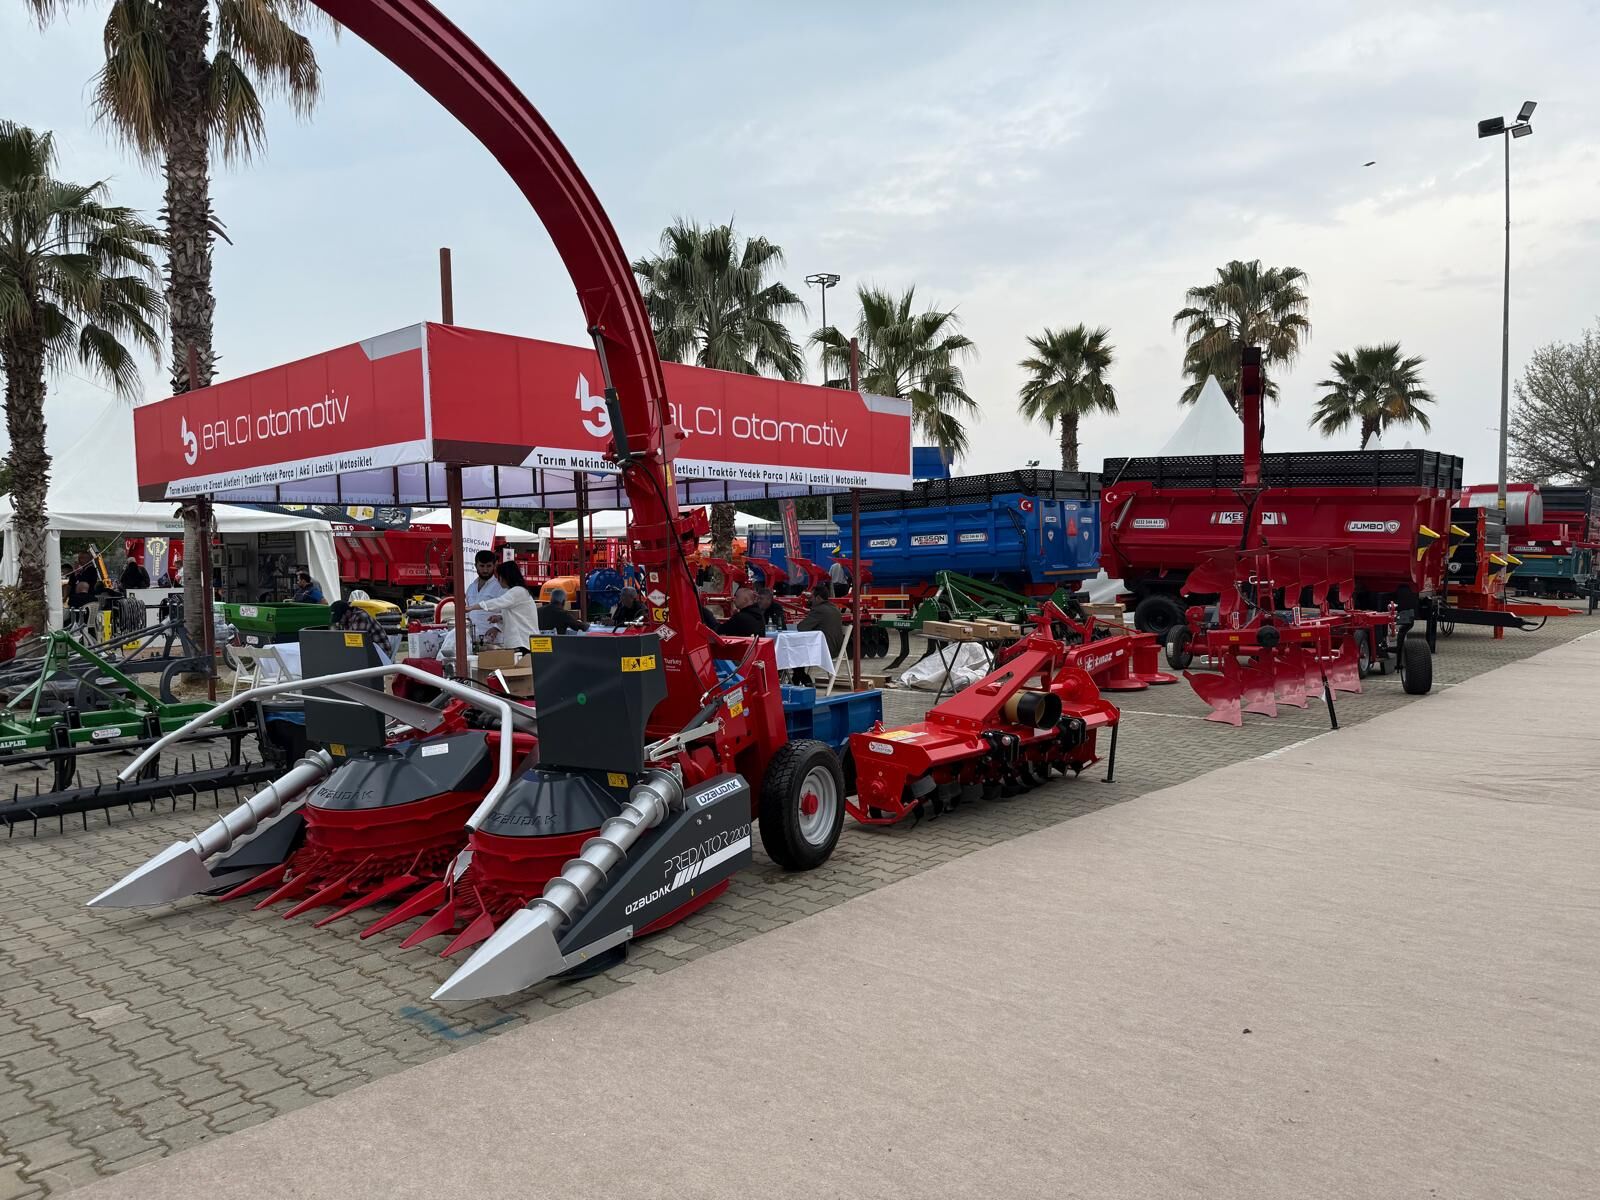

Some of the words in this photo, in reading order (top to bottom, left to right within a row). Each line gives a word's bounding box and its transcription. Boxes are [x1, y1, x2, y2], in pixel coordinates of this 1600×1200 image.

[202, 414, 252, 451] BALCI
[256, 389, 350, 440] otomotiv
[732, 413, 848, 448] otomotiv
[315, 461, 334, 473] Lastik
[339, 455, 373, 469] Motosiklet
[536, 453, 567, 467] Tarım
[674, 463, 700, 475] letleri
[708, 466, 737, 478] Traktör
[739, 469, 761, 480] Yedek
[763, 471, 783, 483] Parça
[789, 472, 803, 482] Akü
[809, 473, 830, 484] Lastik
[835, 475, 867, 486] Motosiklet
[914, 534, 945, 543] KESSAN
[1351, 522, 1384, 531] JUMBO
[663, 830, 729, 879] PREDATOR
[730, 822, 750, 843] 2200
